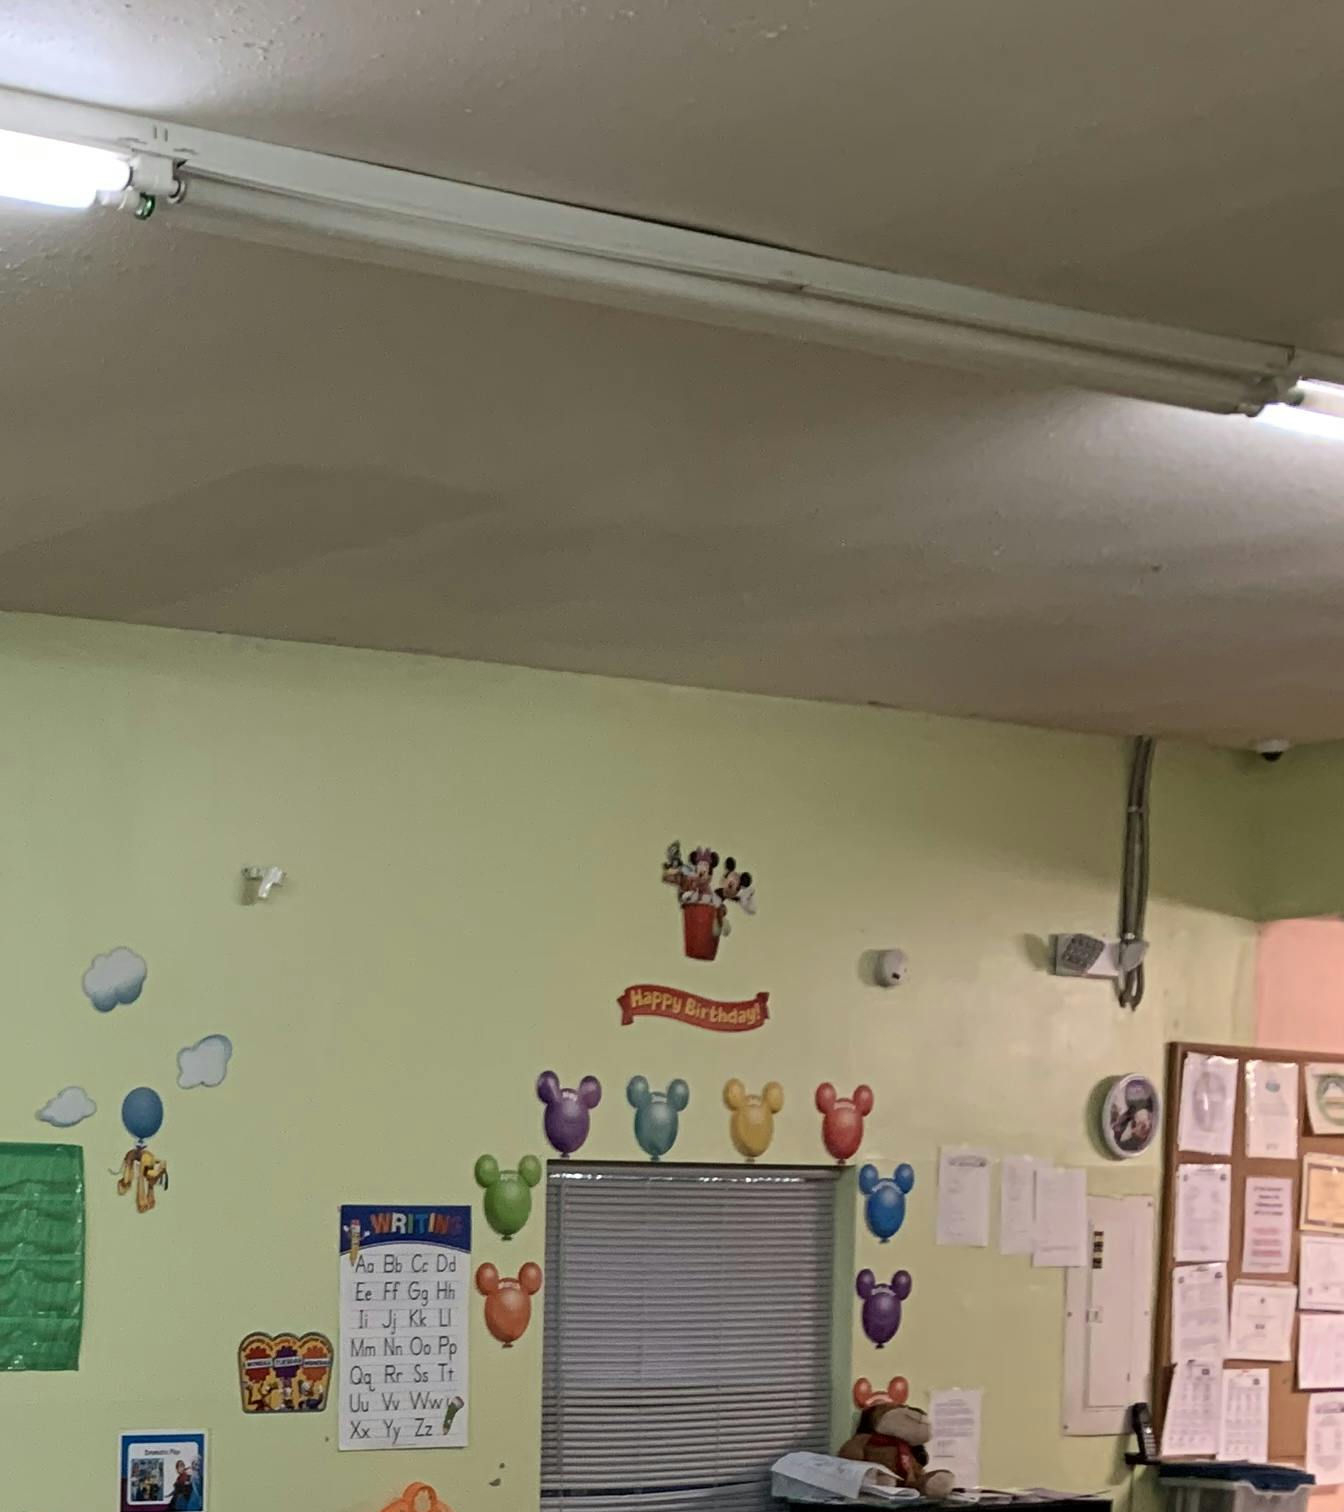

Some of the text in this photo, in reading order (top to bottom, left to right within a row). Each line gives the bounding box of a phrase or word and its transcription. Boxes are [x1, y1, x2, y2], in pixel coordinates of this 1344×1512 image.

[629, 989, 761, 1026] Happy Birthday!
[369, 1212, 462, 1234] WRITING
[355, 1253, 456, 1274] Aa Bb Cc Dd
[355, 1280, 455, 1307] Ee Ff Gg Hh
[358, 1309, 369, 1329] Ii
[382, 1309, 397, 1334] Jj
[409, 1309, 427, 1328] Kk
[350, 1336, 457, 1361] Mm Nn Oo Pp
[350, 1363, 454, 1392] Qq Rr Ss Tt
[349, 1391, 444, 1413] Uu Vv Ww
[350, 1418, 433, 1445] Xx Yy Zz
